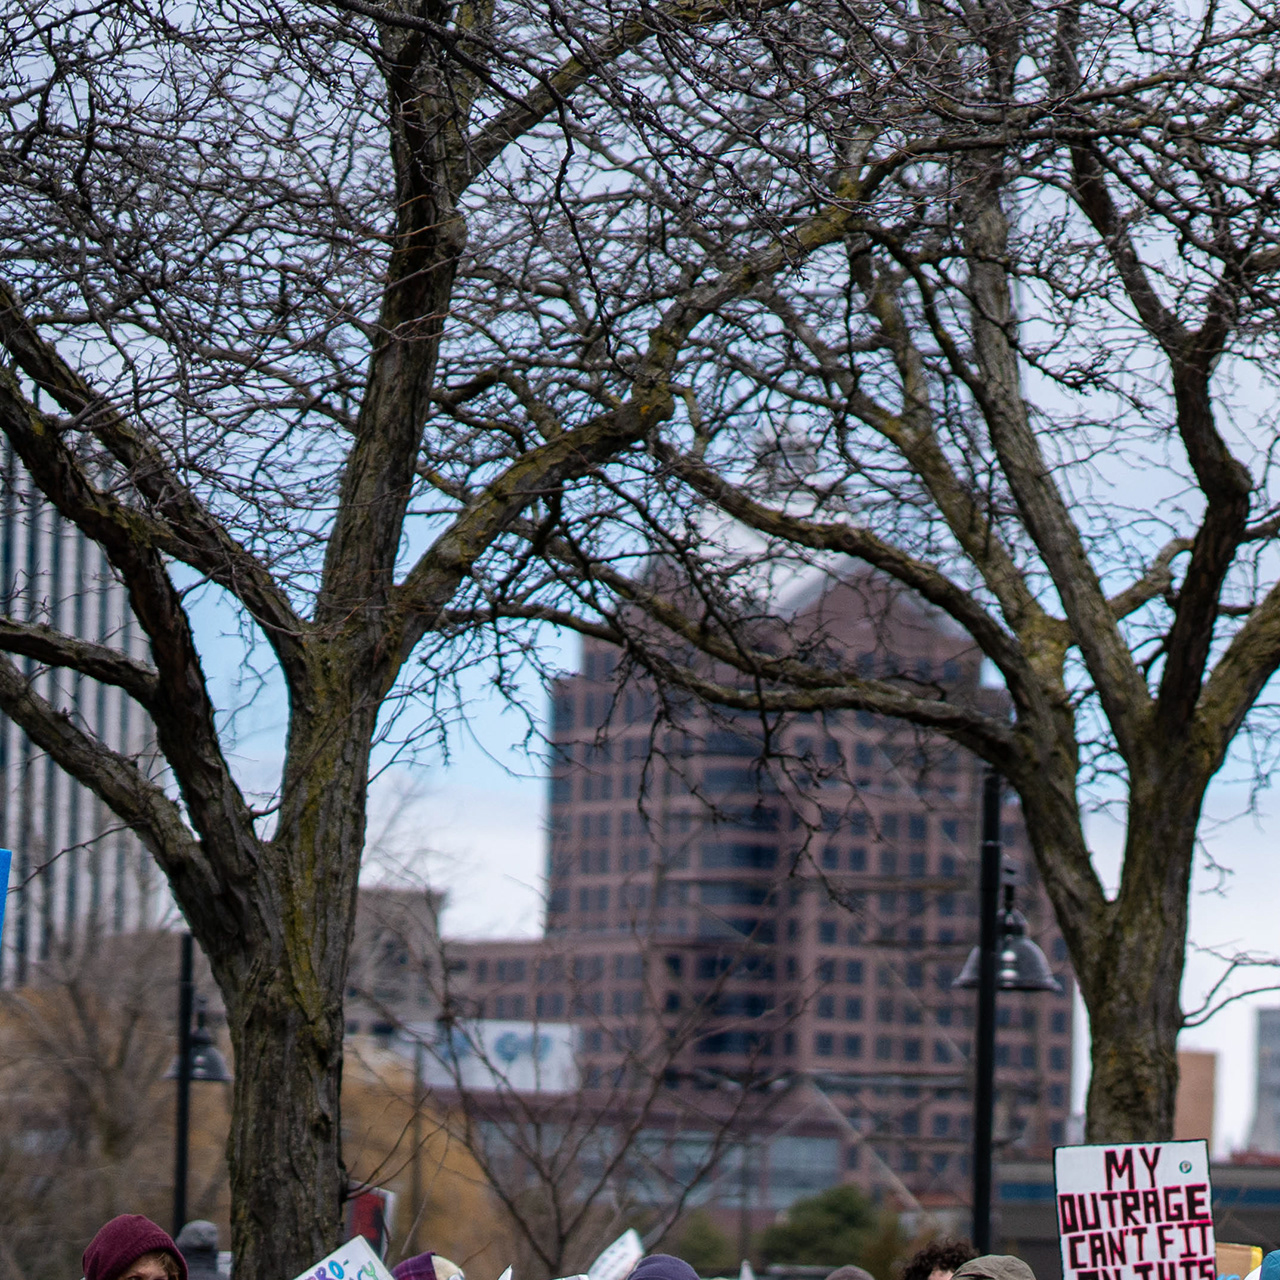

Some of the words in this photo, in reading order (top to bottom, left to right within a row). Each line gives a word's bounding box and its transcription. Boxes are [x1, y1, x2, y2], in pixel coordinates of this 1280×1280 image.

[1104, 1147, 1161, 1191] MY
[1057, 1183, 1211, 1235] OUTRAGE
[1068, 1227, 1148, 1269] CAN'T
[1157, 1220, 1213, 1259] FIT
